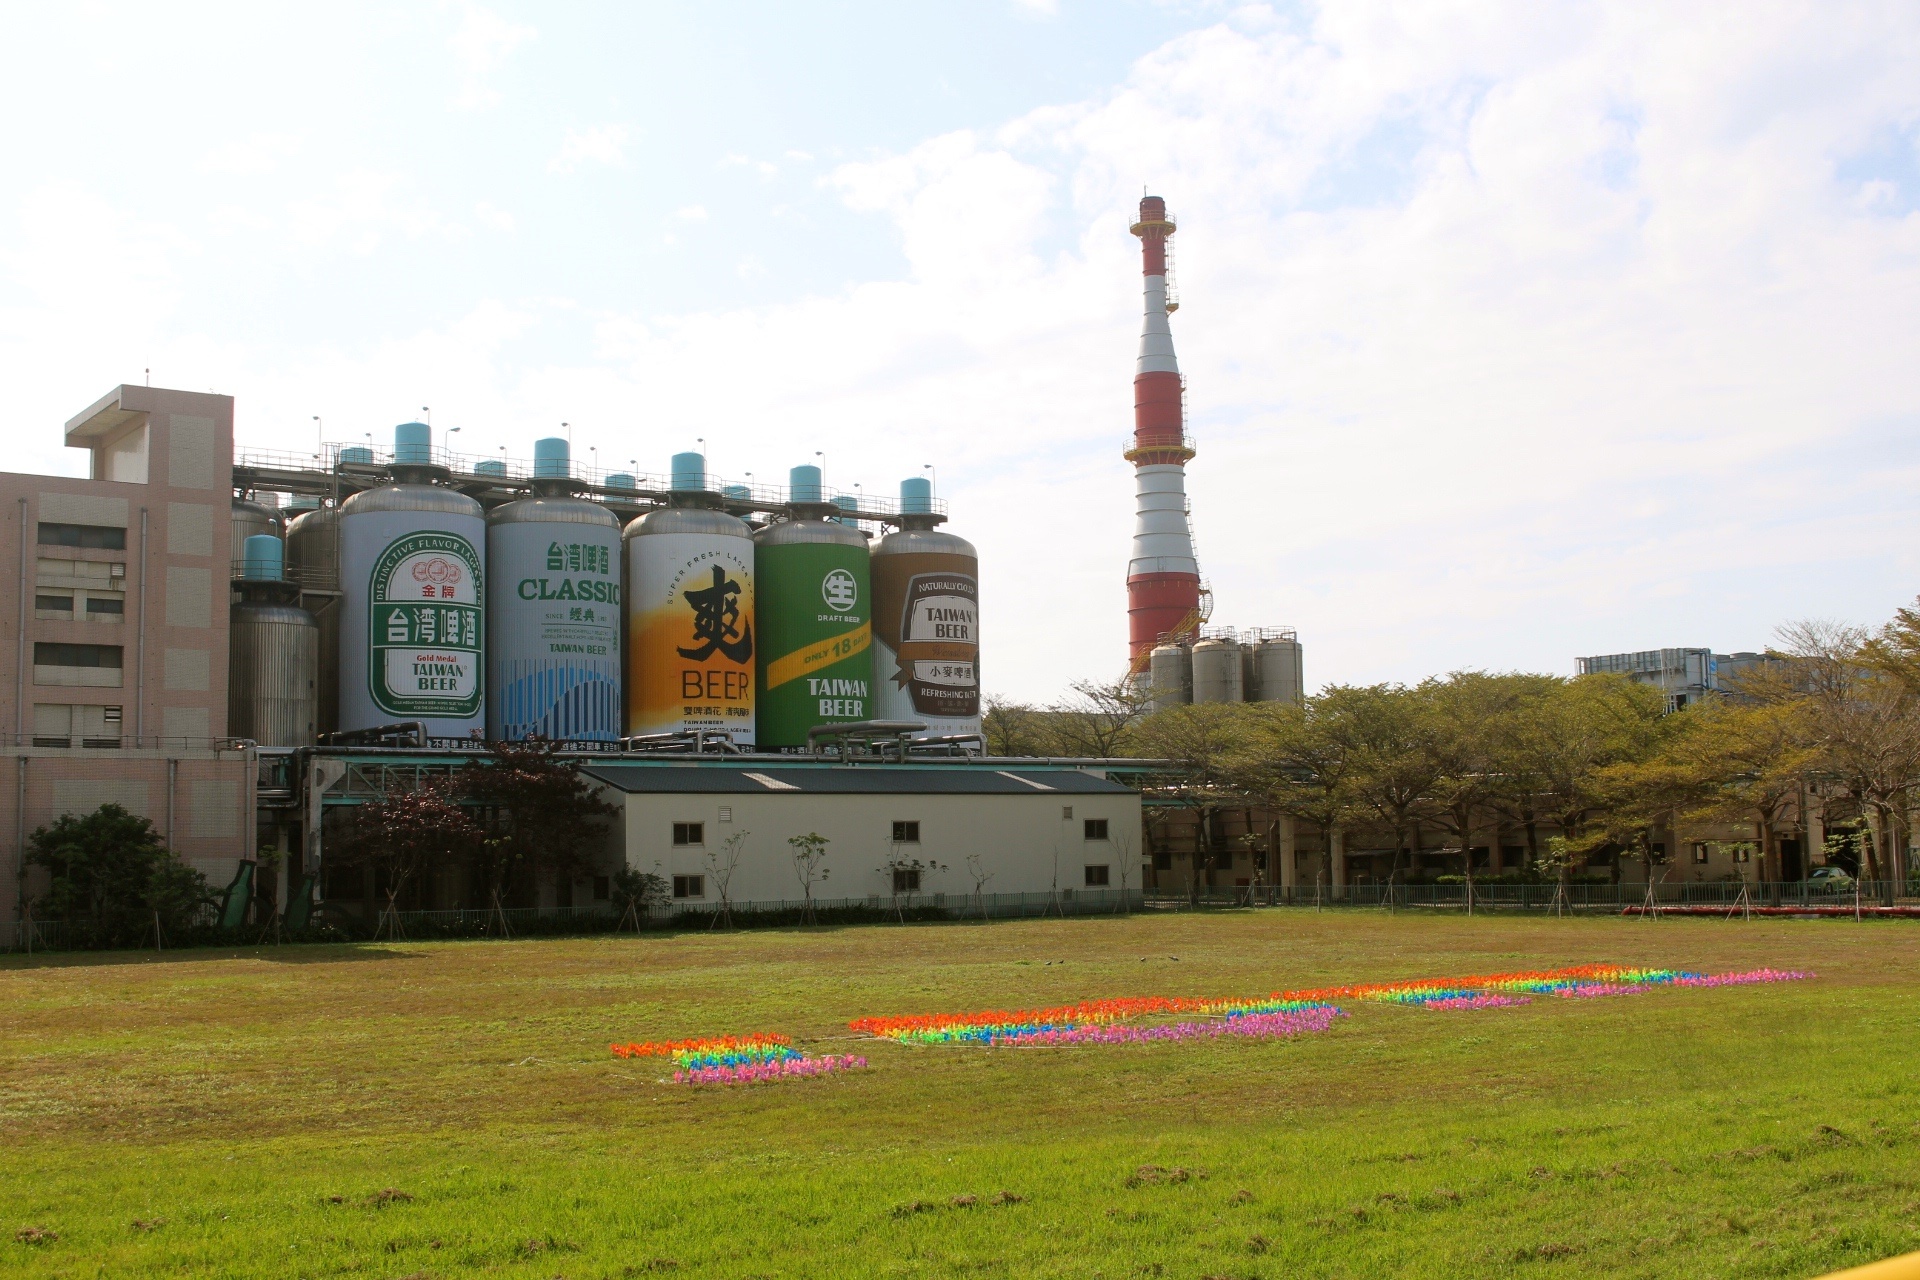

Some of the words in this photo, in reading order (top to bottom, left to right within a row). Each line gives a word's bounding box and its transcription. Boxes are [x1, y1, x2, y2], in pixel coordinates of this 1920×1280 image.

[377, 542, 415, 600] DISTINCTIVE
[419, 539, 461, 551] FLAVOR
[667, 569, 686, 604] SUPER
[687, 551, 721, 568] FRESH
[422, 584, 455, 599] 金牌
[518, 578, 620, 606] CLASSIC
[826, 575, 854, 604] 生
[918, 581, 956, 593] NATURALLY
[569, 607, 595, 623] 經典
[676, 564, 753, 665] 爽
[817, 614, 843, 622] DRAFT
[844, 615, 861, 623] BEER
[925, 607, 972, 624] TAIWAN
[935, 623, 969, 640] BEER
[549, 643, 584, 654] TAIWAN
[586, 644, 607, 656] BEER
[804, 648, 830, 665] ONLY
[831, 637, 852, 658] 18
[416, 654, 434, 662] Gold
[435, 655, 457, 663] Medal
[412, 663, 464, 677] TAIWAN
[929, 664, 972, 680] 小麥啤酒
[418, 677, 458, 691] BEER
[682, 670, 750, 700] BEER
[807, 678, 868, 698] TAIWAN
[921, 688, 964, 699] REFRESHING
[819, 699, 864, 717] BEER
